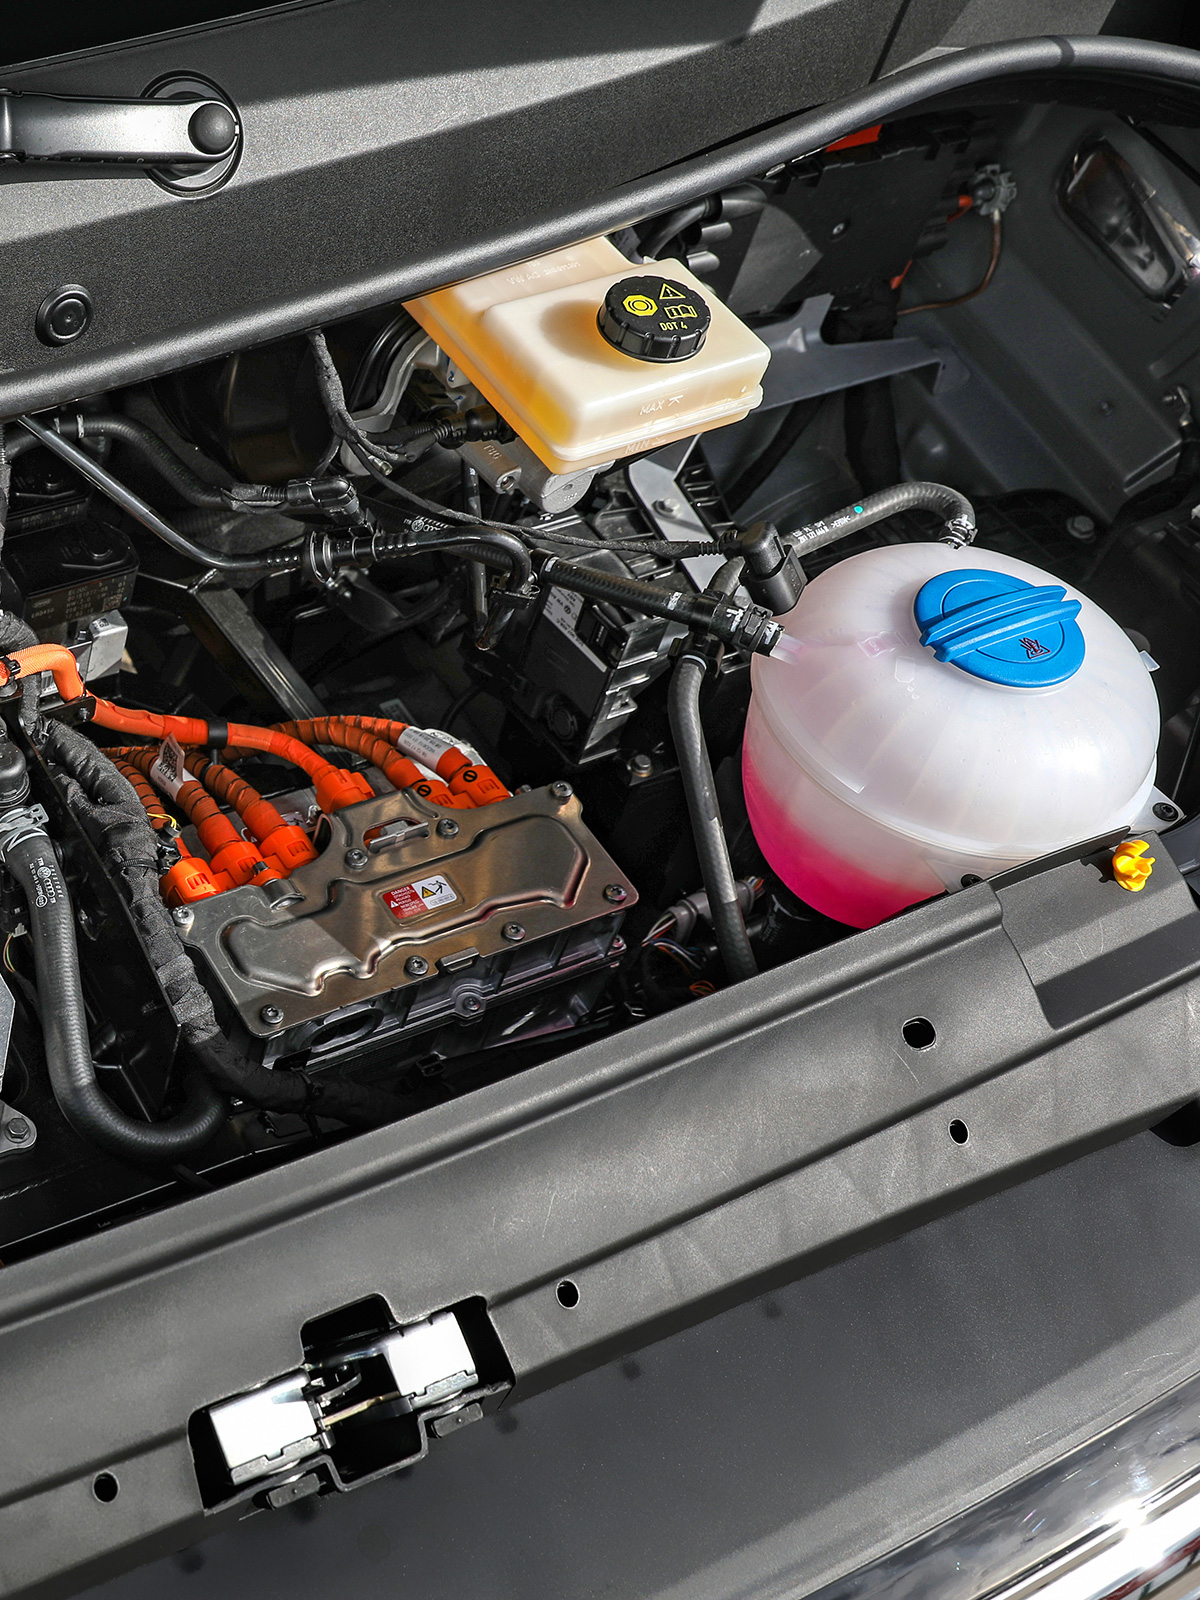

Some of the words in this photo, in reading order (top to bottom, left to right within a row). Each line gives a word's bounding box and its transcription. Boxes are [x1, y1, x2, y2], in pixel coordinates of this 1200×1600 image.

[659, 322, 678, 331] DOT
[680, 321, 688, 330] 4
[639, 400, 666, 416] MAX
[625, 440, 652, 454] MIN
